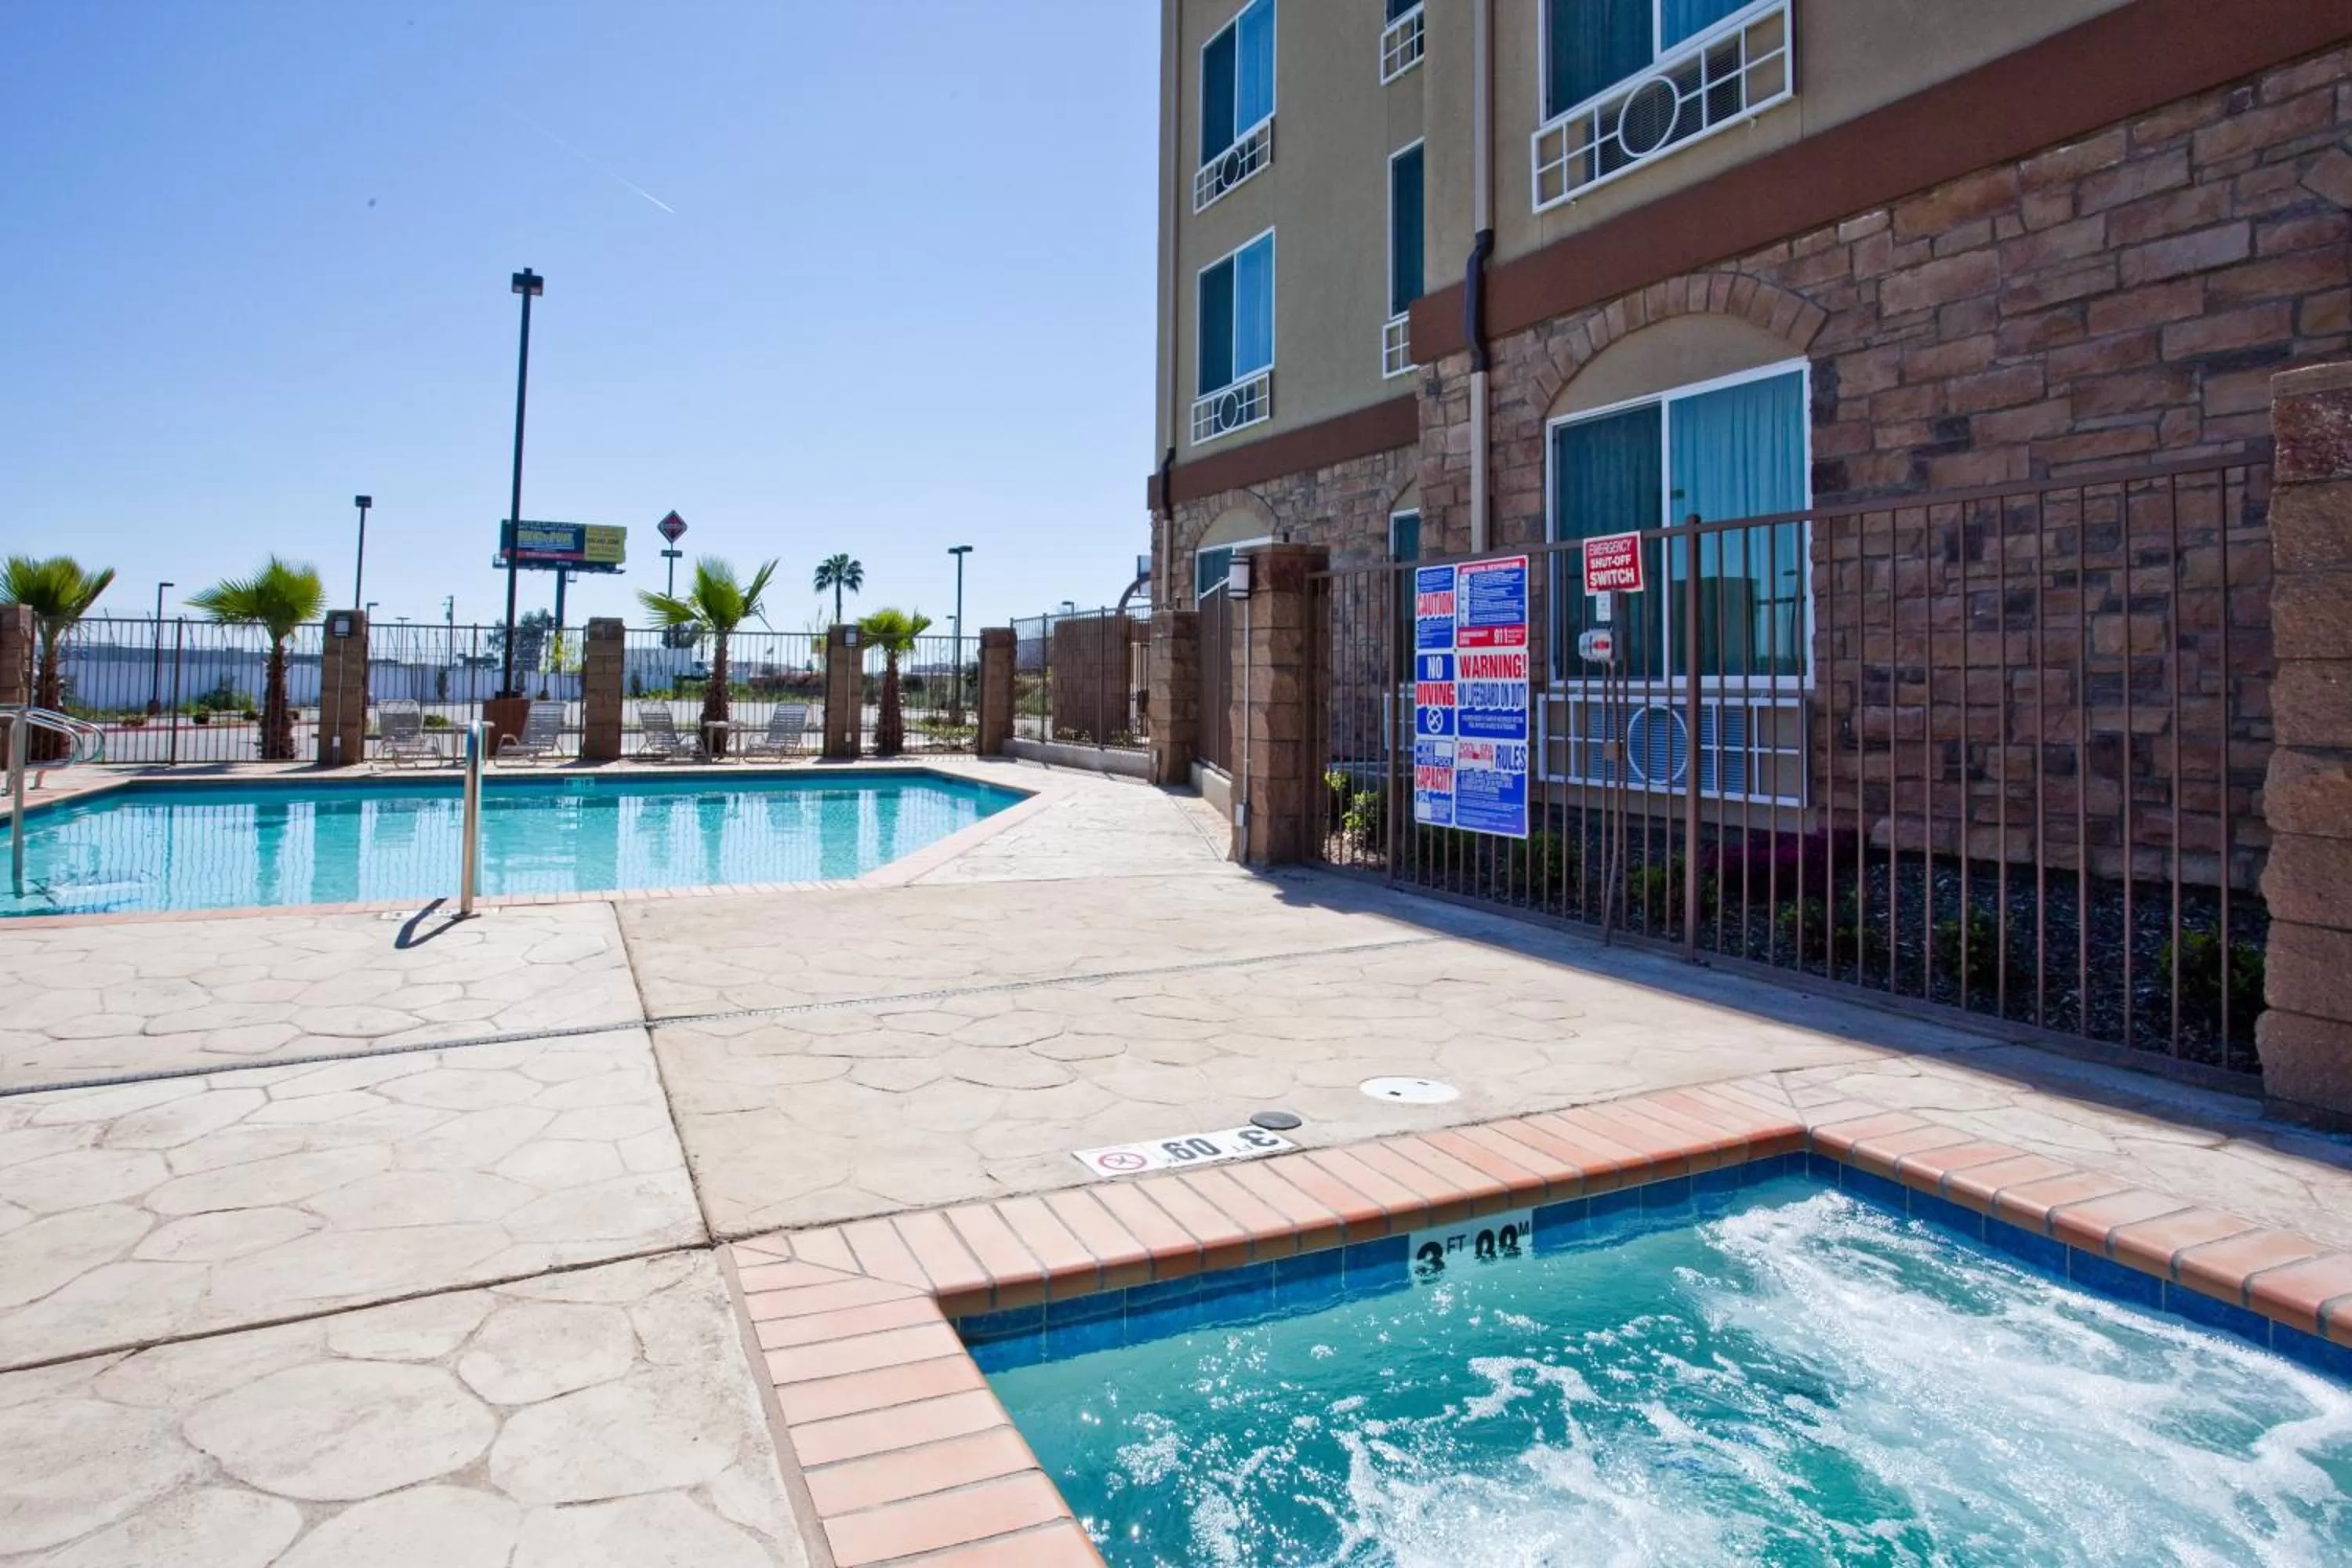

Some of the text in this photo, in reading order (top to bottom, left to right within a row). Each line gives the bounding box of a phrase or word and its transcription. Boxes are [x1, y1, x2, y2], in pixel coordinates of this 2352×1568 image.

[1588, 539, 1632, 555] EMERGENCY
[1590, 555, 1631, 568] SHUT-OFF
[1589, 568, 1635, 586] SWITCH
[1417, 593, 1454, 616] CAUTION
[1494, 628, 1508, 644] 911
[1427, 655, 1443, 680] NO
[1459, 654, 1526, 679] WARNING!
[1416, 683, 1455, 706] DIVING
[1495, 745, 1526, 771] RULES
[1416, 767, 1454, 791] CAPACITY
[1446, 1234, 1467, 1254] FT
[1519, 1220, 1530, 1236] M
